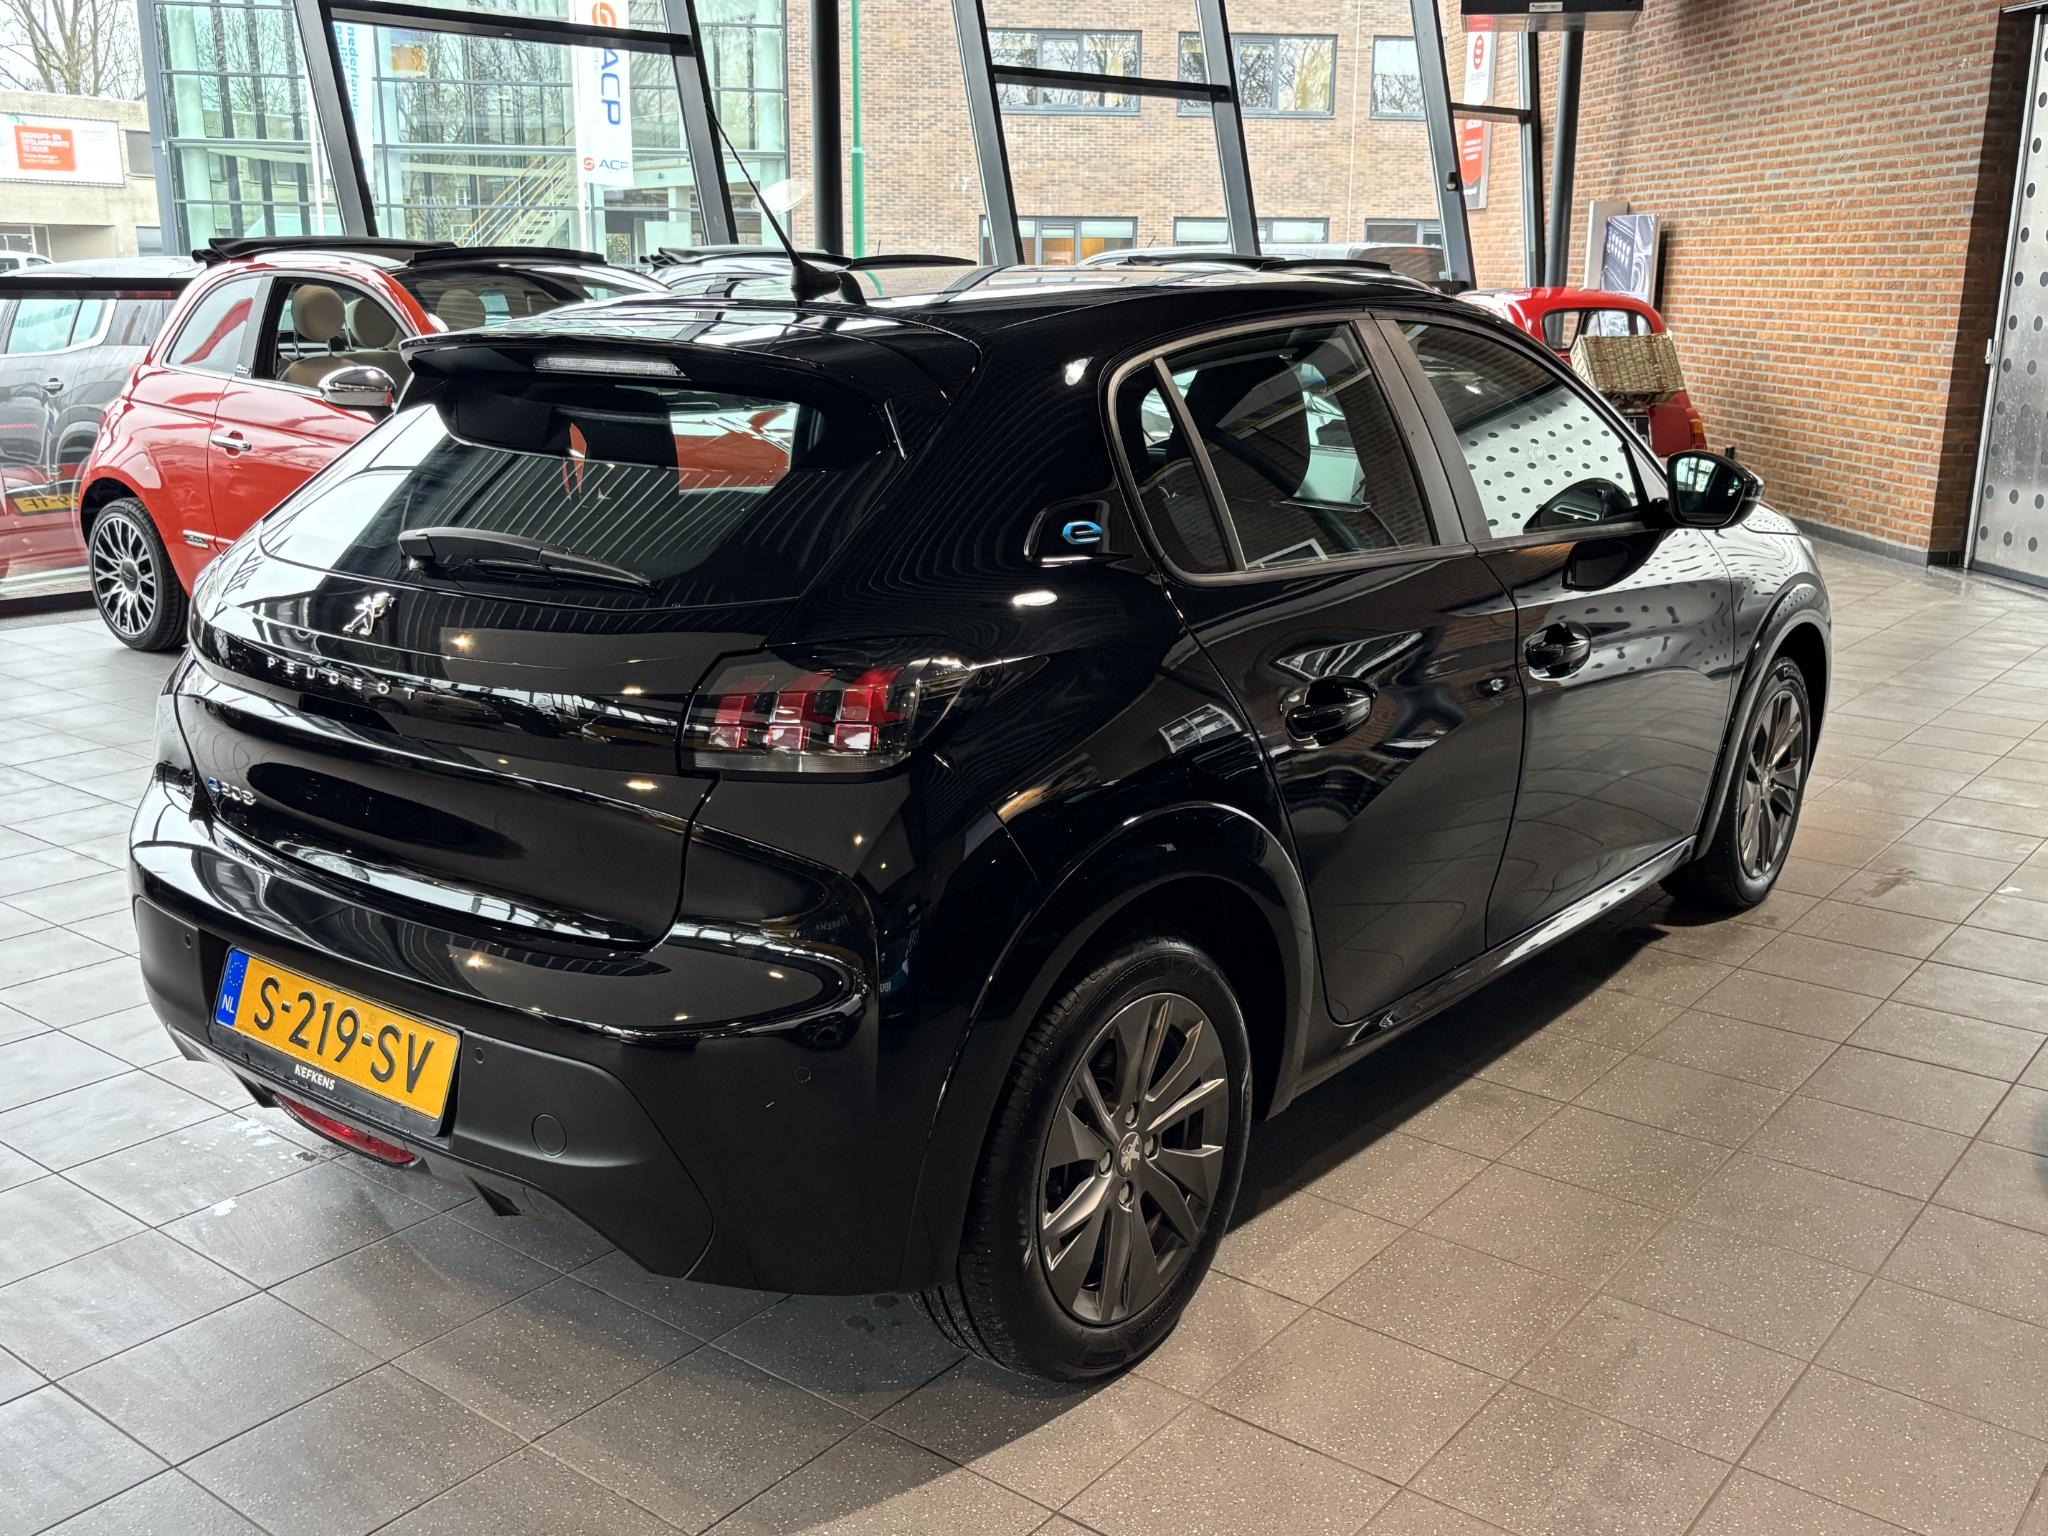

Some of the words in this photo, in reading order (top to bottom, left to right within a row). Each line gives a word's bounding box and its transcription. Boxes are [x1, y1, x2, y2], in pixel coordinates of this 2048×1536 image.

[601, 48, 621, 125] ACP
[267, 656, 415, 700] PEUGEOT
[221, 993, 234, 1014] NL
[254, 976, 434, 1093] S-219-SV
[294, 1063, 335, 1091] NEFKENS
